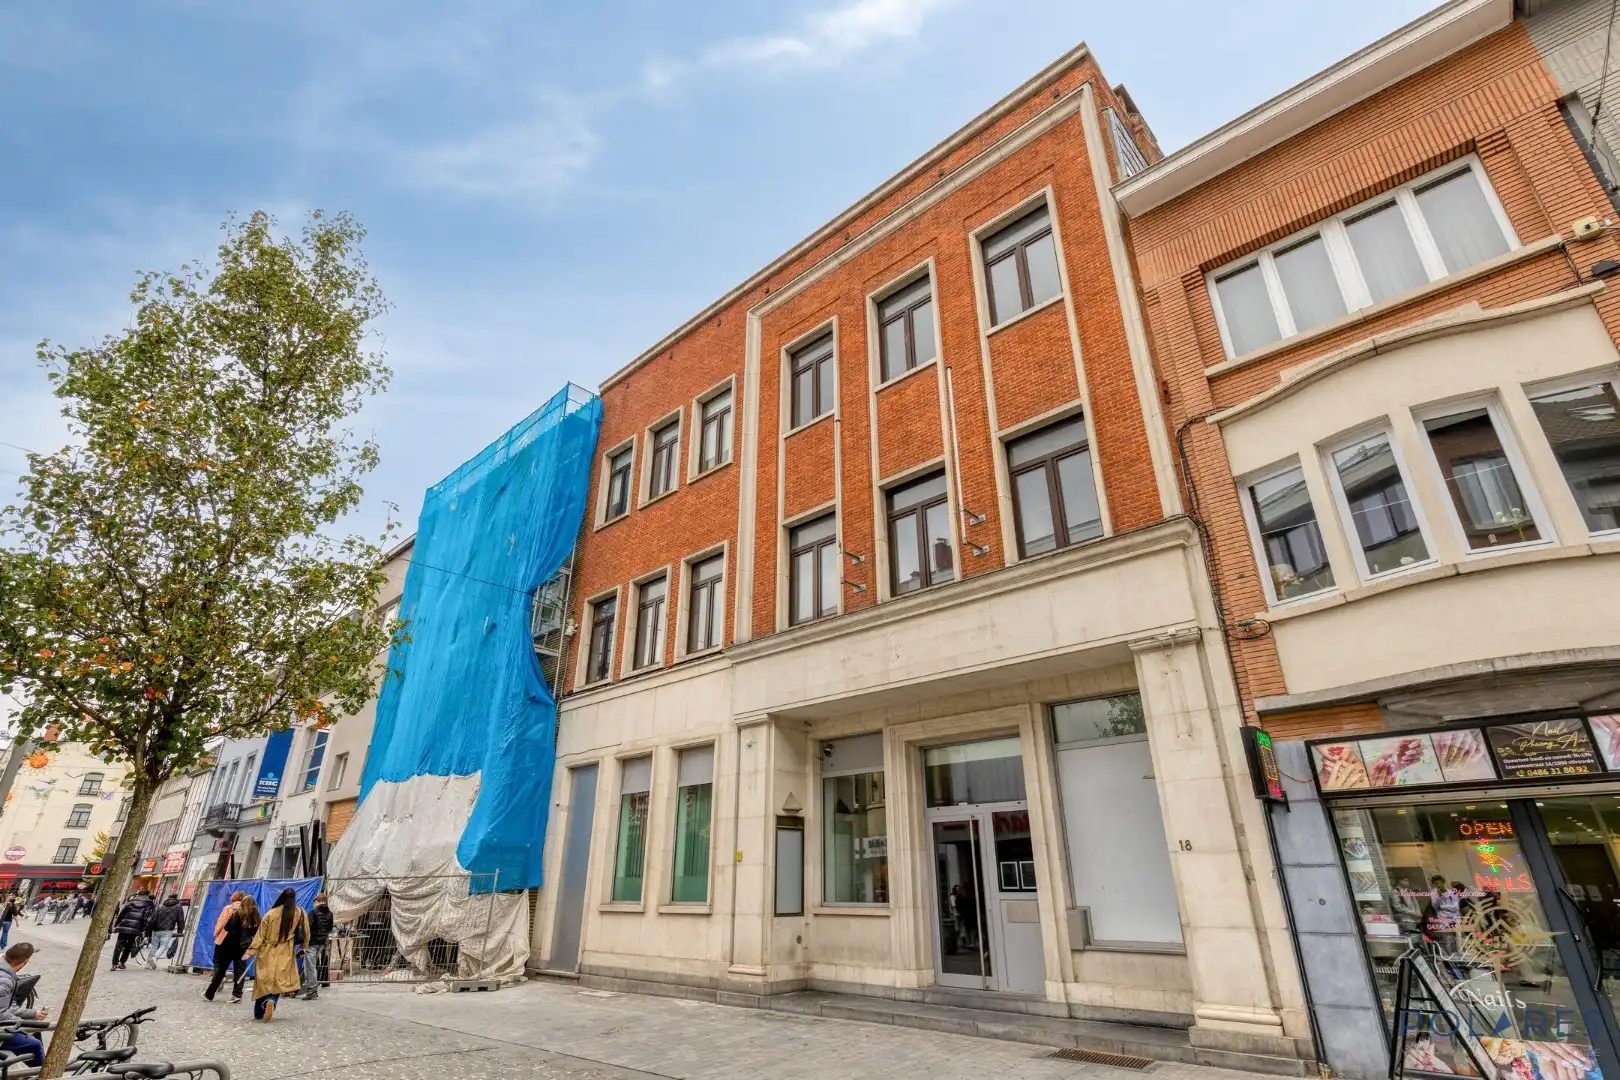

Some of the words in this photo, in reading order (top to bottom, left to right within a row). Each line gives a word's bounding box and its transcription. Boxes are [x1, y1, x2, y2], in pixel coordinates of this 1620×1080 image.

[1526, 769, 1549, 777] 0486
[1459, 823, 1513, 835] OPEN
[1178, 839, 1193, 852] 18
[1458, 987, 1528, 1012] Nails
